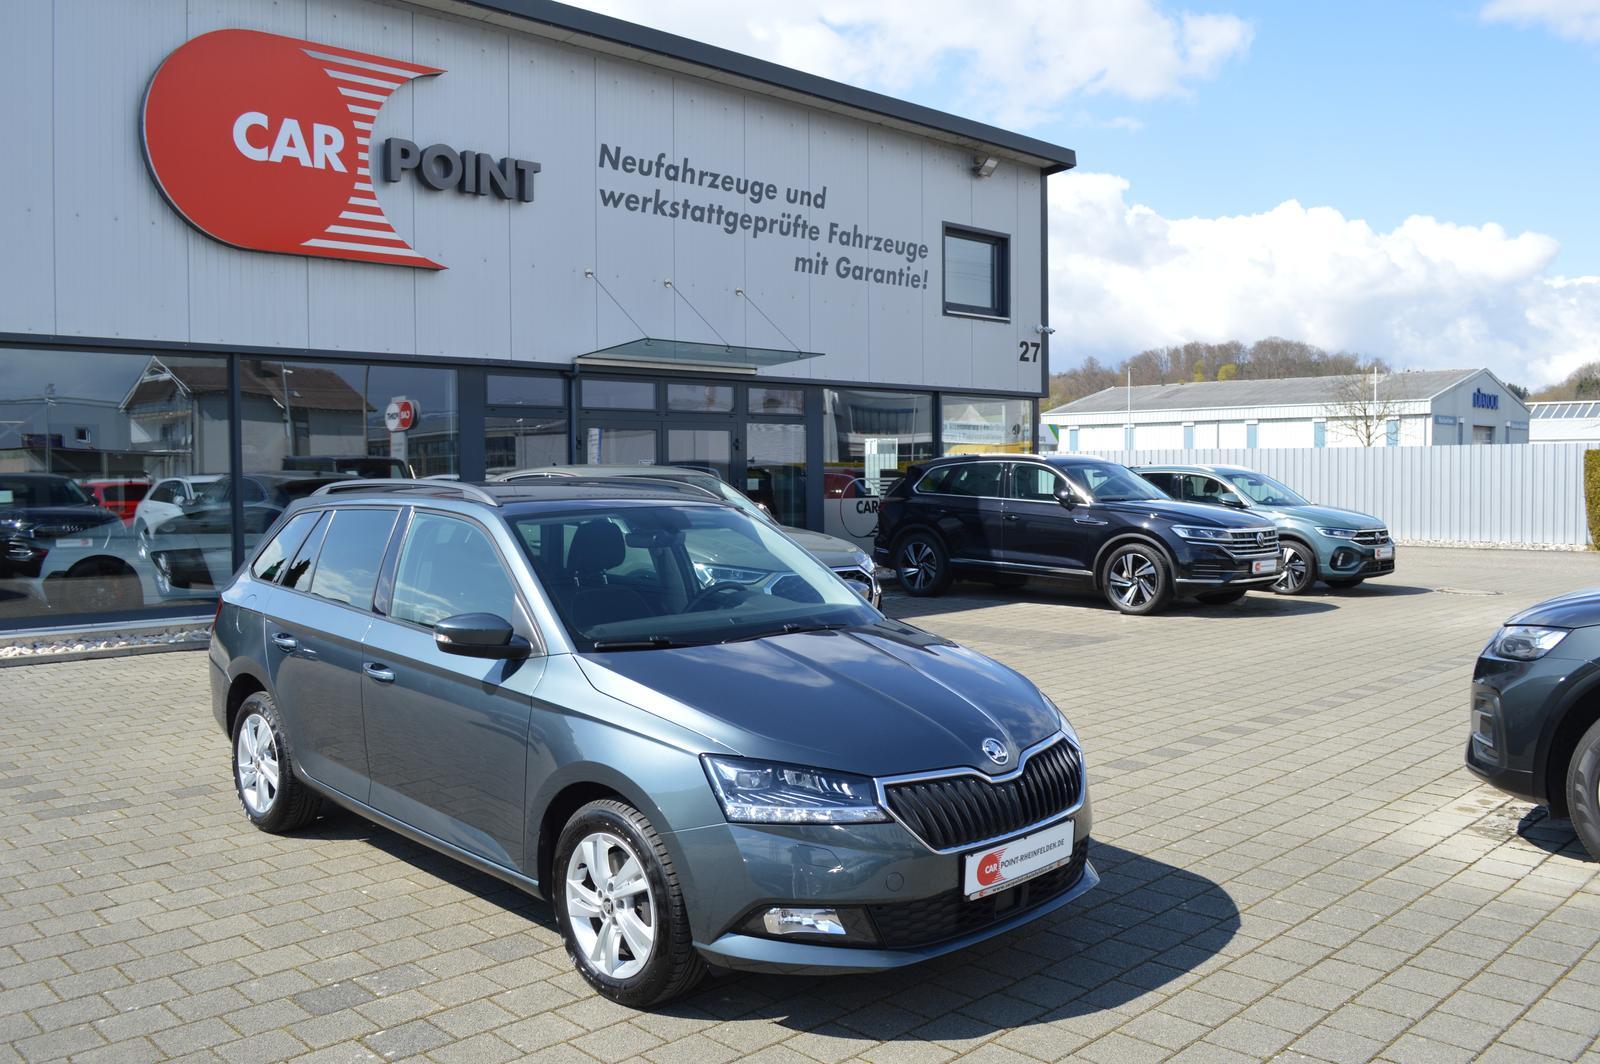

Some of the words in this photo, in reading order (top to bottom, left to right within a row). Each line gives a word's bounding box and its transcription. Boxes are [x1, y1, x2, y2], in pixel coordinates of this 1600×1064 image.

[232, 111, 347, 173] CAR
[384, 137, 541, 202] POINT
[598, 143, 778, 204] Neufahrzeuge
[786, 186, 827, 209] und
[599, 188, 820, 241] werkstattgeprüfte
[828, 222, 929, 263] Fahrzeuge
[794, 252, 829, 276] mit
[835, 256, 929, 290] Garantie!
[1019, 341, 1041, 363] 27
[856, 500, 879, 514] CAR
[984, 861, 998, 874] CAR
